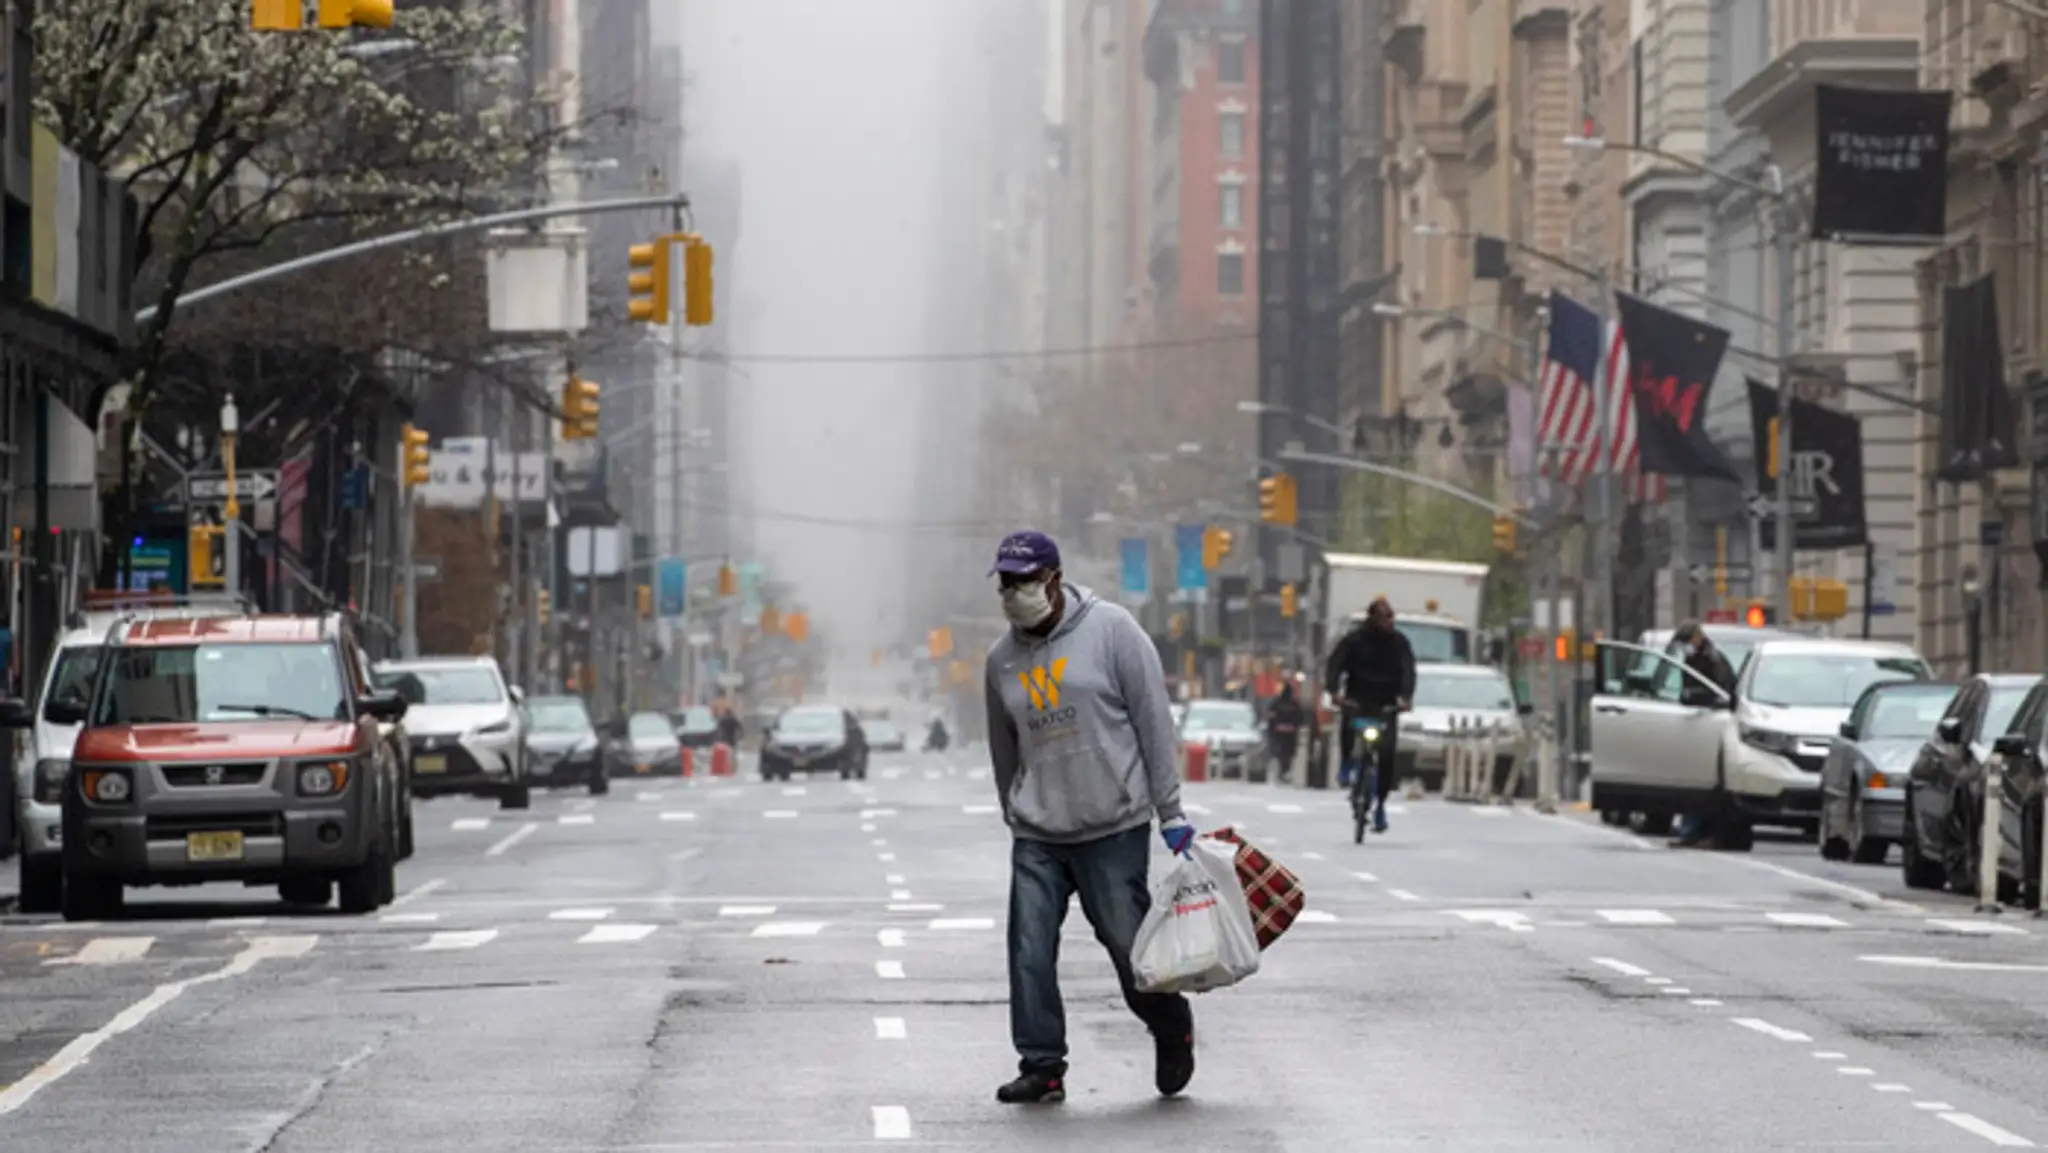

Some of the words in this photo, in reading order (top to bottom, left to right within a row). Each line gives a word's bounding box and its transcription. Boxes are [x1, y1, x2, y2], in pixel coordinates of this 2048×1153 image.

[1828, 132, 1937, 152] JENNIFER
[1838, 150, 1920, 170] FISHER
[480, 463, 542, 492] Gry
